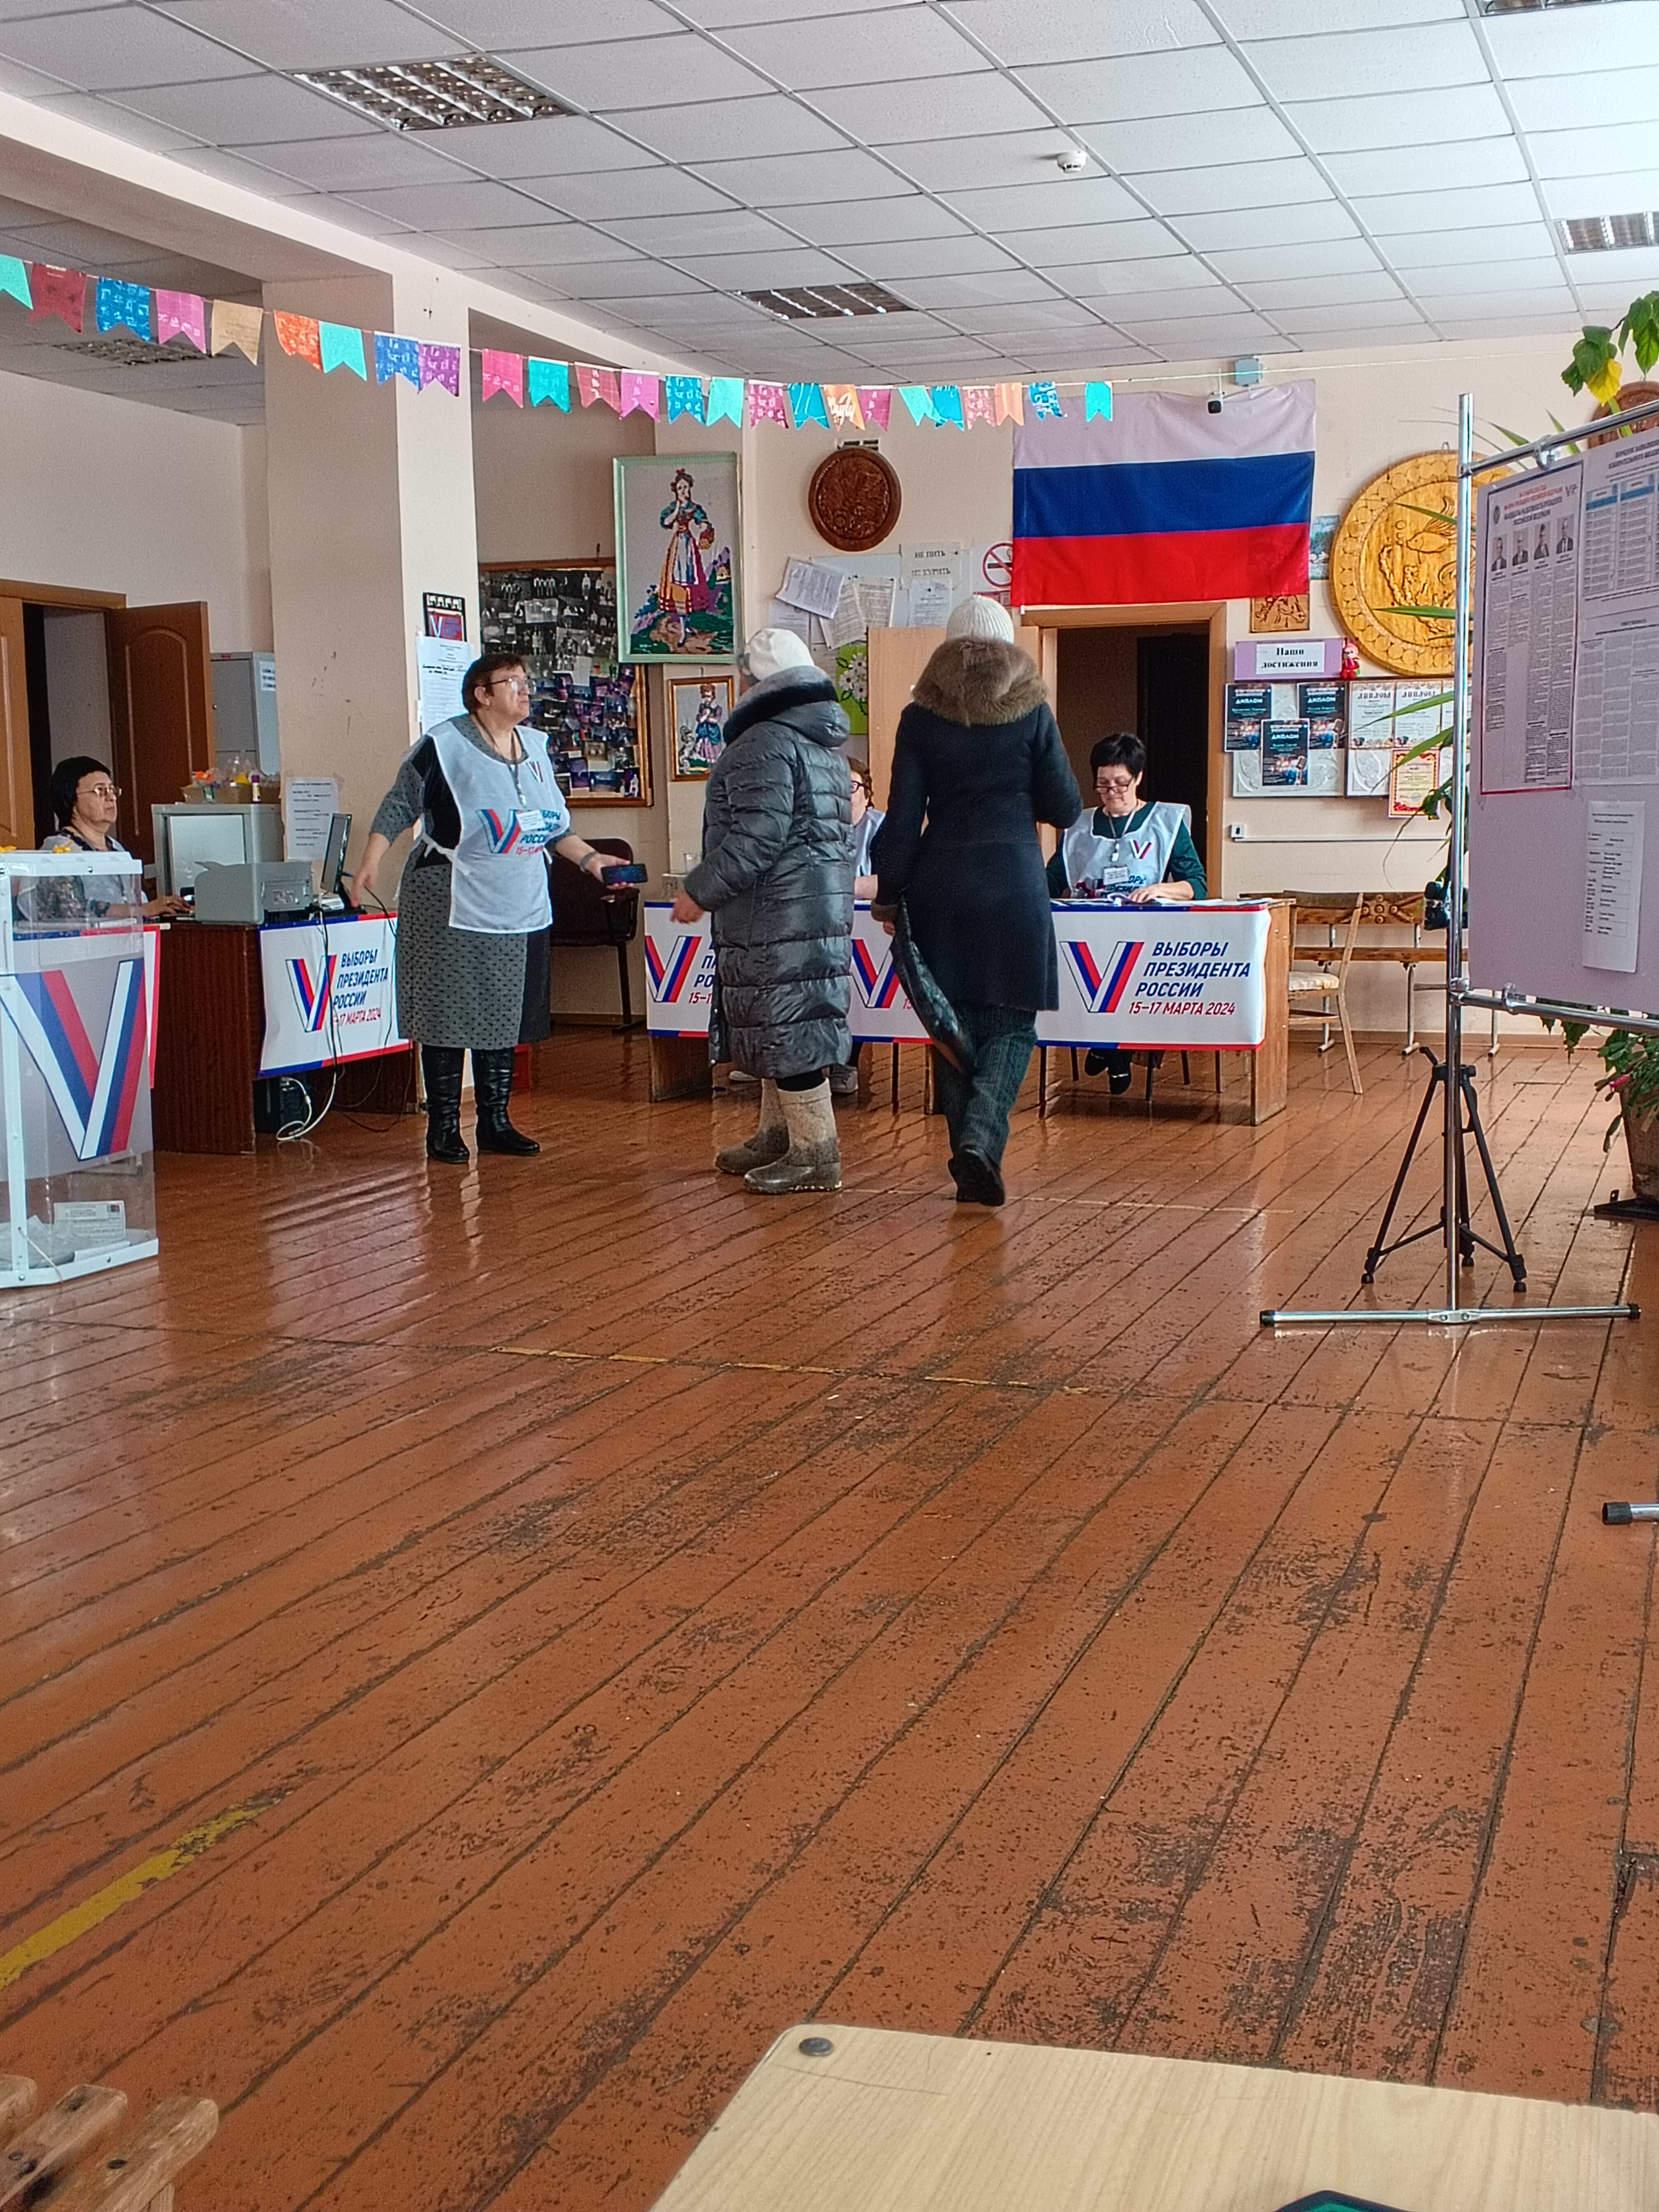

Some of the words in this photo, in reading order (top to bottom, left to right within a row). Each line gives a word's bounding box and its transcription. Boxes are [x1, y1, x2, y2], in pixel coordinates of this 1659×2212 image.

[1276, 647, 1305, 656] Наши
[1261, 659, 1319, 669] достижения
[1152, 941, 1230, 957] ВЫБОРЫ
[341, 949, 378, 968] ВЫБОРЫ
[336, 967, 389, 989] ПРЕЗИДЕНТА
[1142, 962, 1251, 979] ПРЕЗИДЕНТА
[1134, 982, 1204, 997] РОССИИ
[333, 991, 367, 1010] РОССИИ
[346, 1010, 366, 1026] МАРТА
[366, 1007, 382, 1021] 2024
[1163, 1002, 1203, 1015] МАРТА
[1205, 1002, 1236, 1016] 2024
